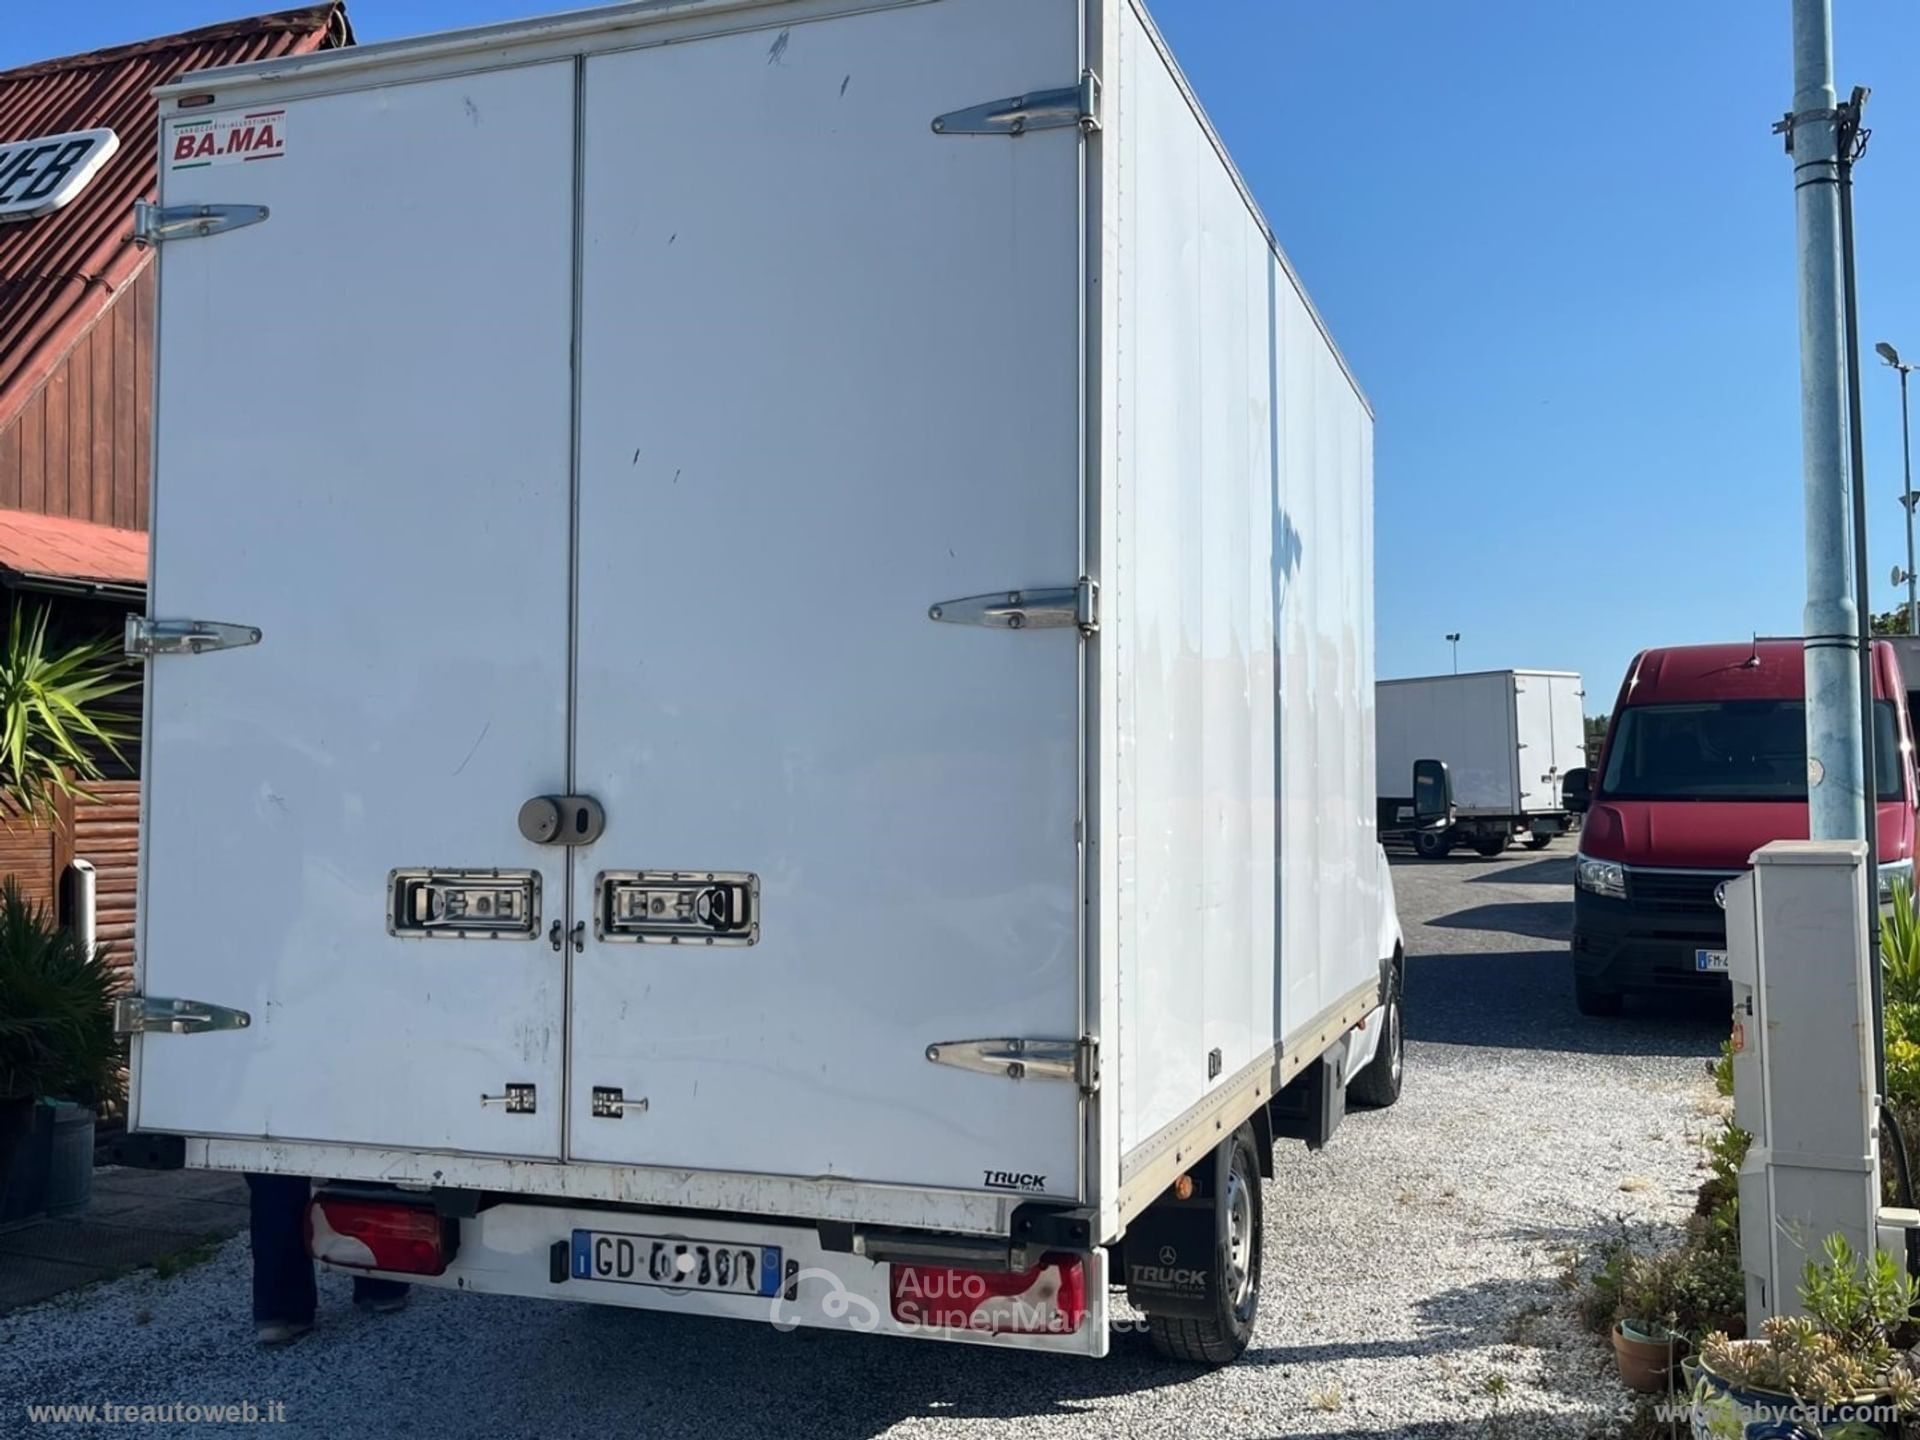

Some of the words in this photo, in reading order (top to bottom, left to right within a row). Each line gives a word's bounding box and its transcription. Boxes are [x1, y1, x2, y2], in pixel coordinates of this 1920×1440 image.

[173, 124, 283, 160] BA.MA.
[984, 1170, 1046, 1189] TRUCK
[1130, 1265, 1207, 1285] TRUCK
